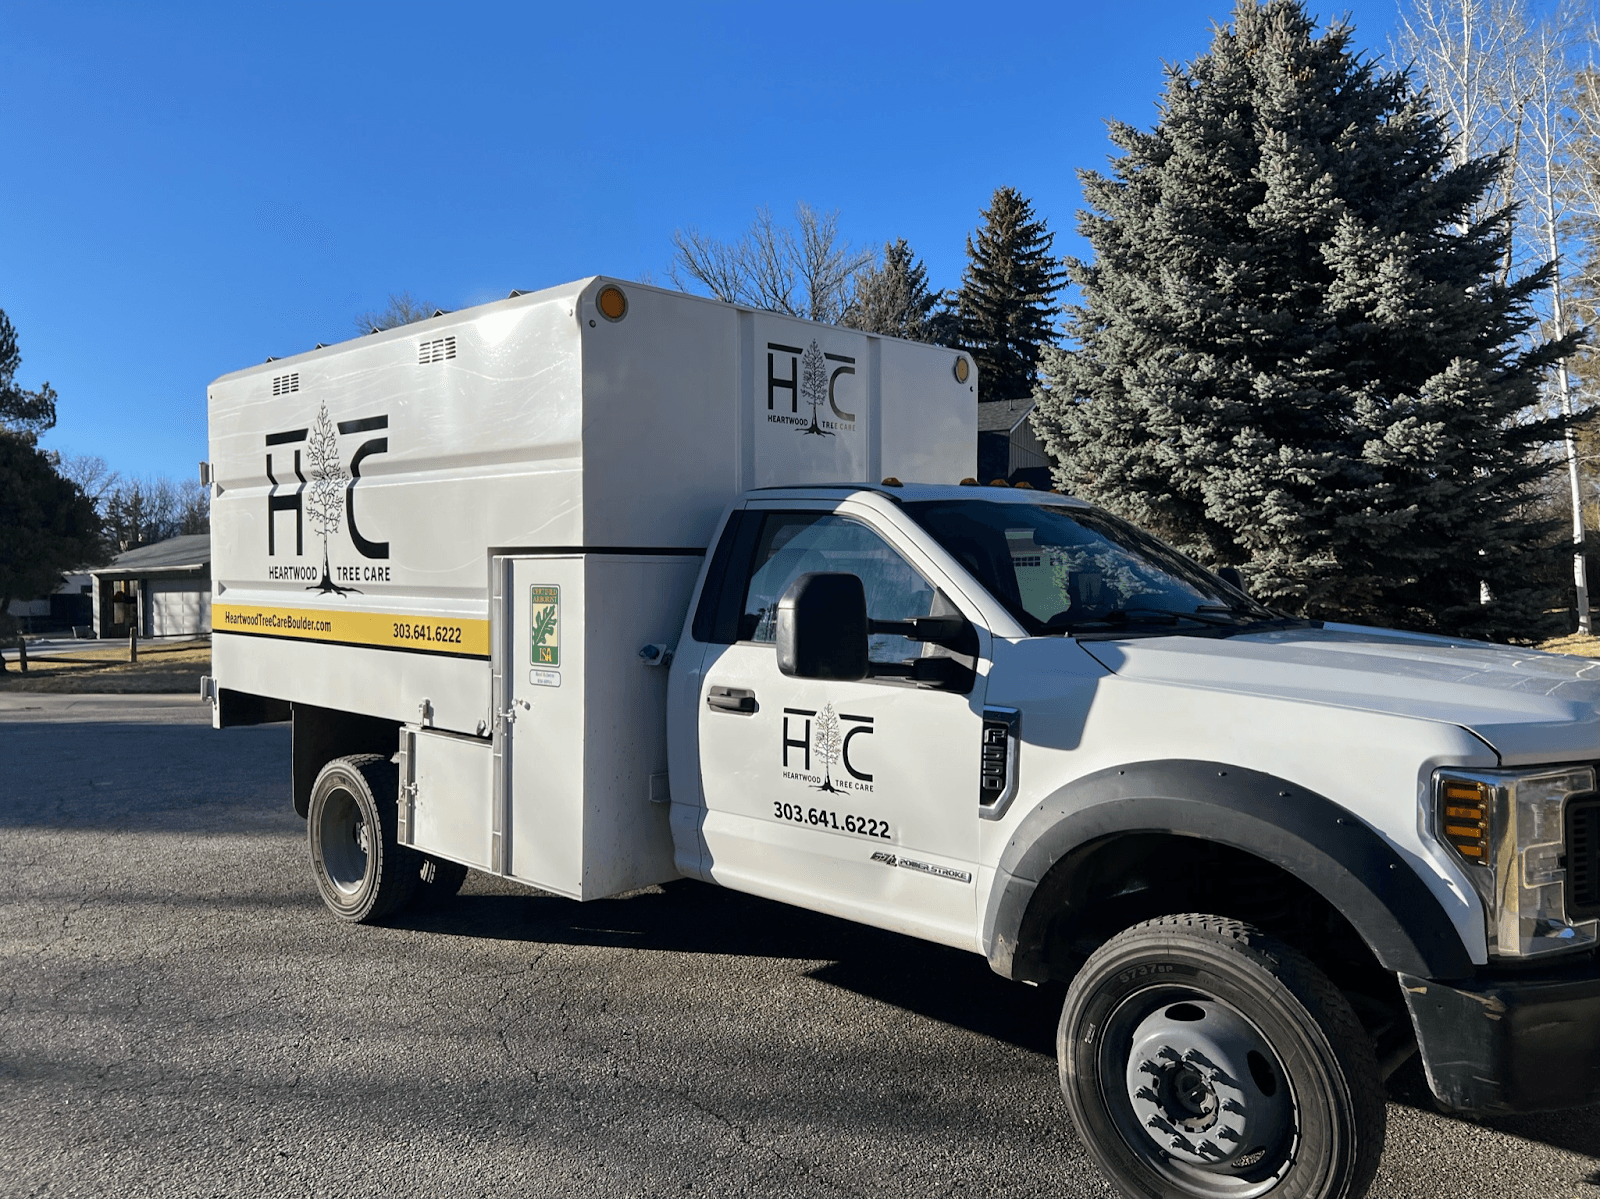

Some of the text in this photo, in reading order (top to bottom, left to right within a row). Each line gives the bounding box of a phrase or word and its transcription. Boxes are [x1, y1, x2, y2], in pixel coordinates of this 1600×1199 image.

[767, 414, 856, 431] HEARTWOOD TREE CARE
[268, 565, 391, 582] HEARTWOOD TREE CARE
[224, 610, 332, 633] HeartwoodTreeCareBoulder.com
[392, 622, 462, 644] 303.641.6222
[539, 647, 552, 662] ISA
[782, 770, 874, 793] HEARTWOOD TREE CARE
[773, 801, 891, 840] 303.641.6222
[899, 858, 929, 871] POWER
[930, 865, 967, 880] STROKE
